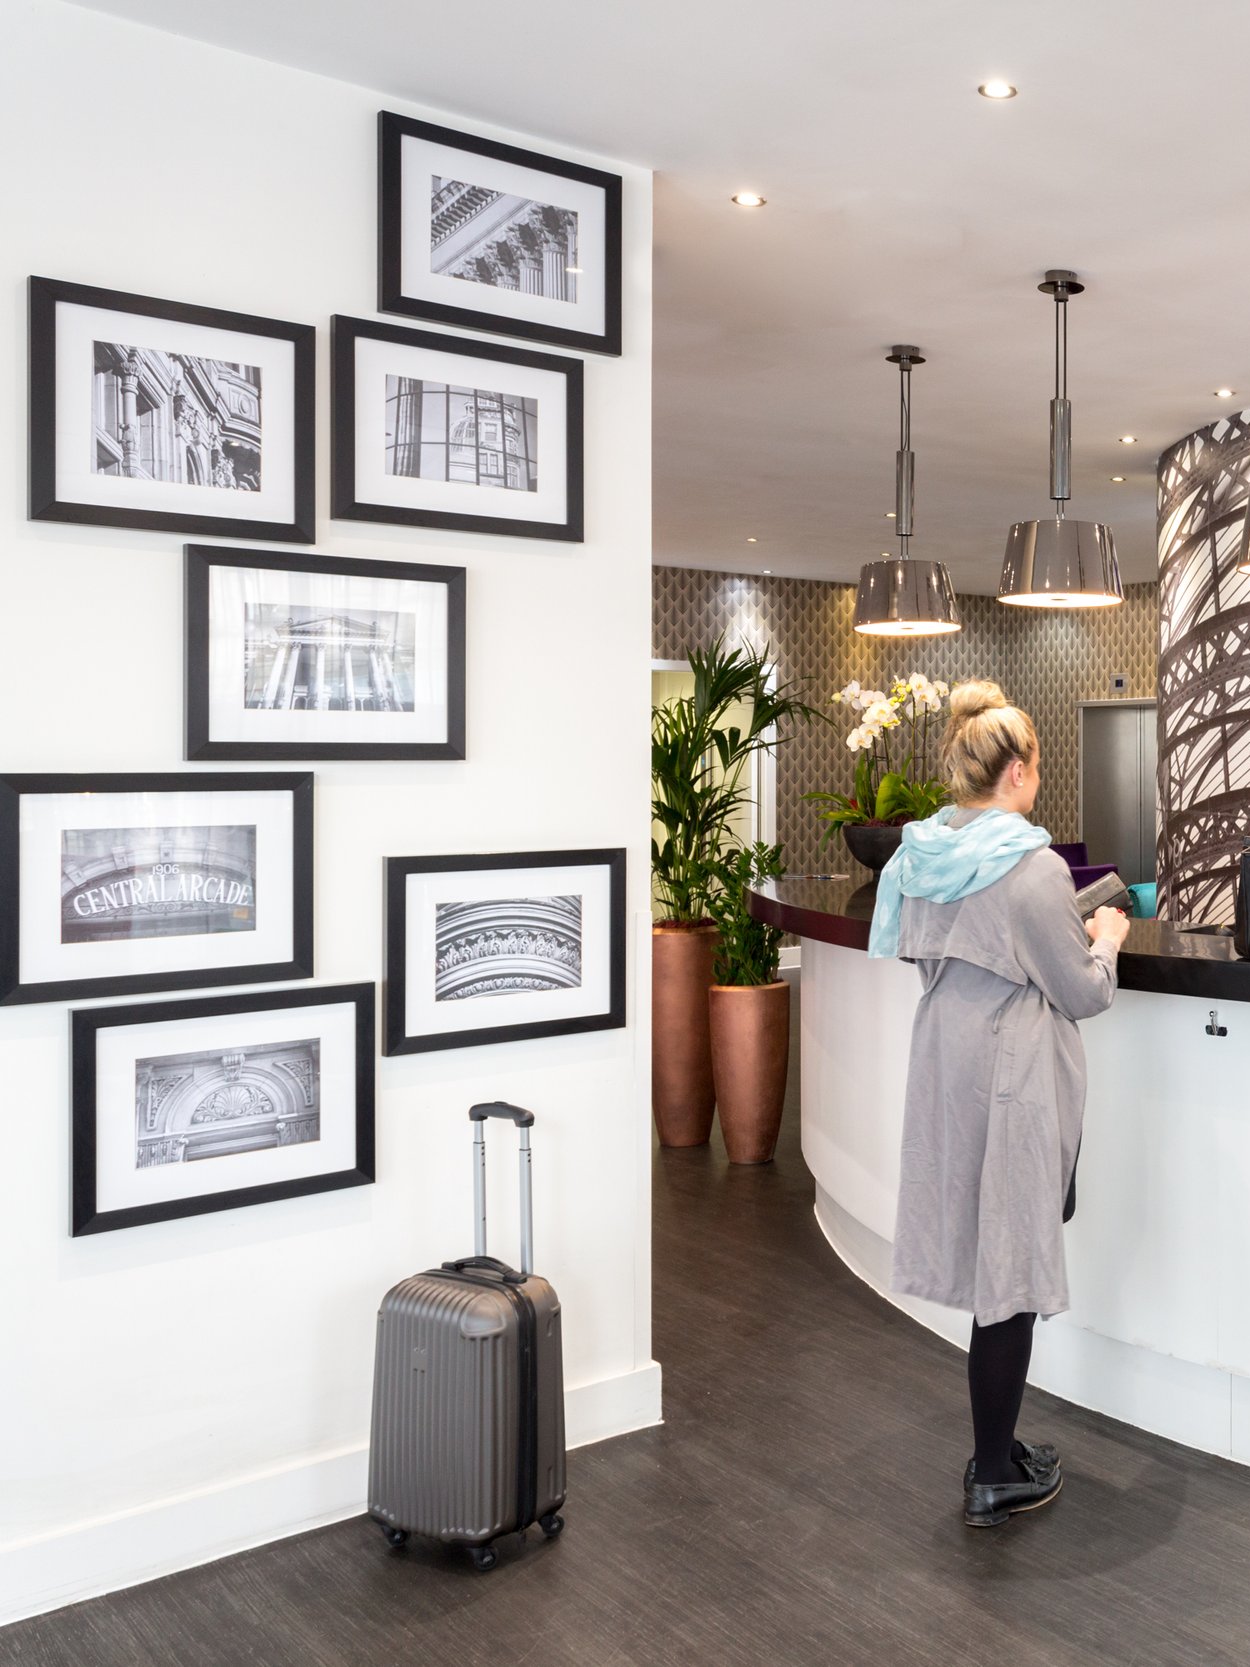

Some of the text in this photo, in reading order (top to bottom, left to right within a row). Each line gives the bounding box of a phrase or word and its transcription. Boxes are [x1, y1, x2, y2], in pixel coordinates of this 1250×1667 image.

[152, 863, 180, 875] 1906
[73, 874, 253, 917] CENTRAL ARCADE
